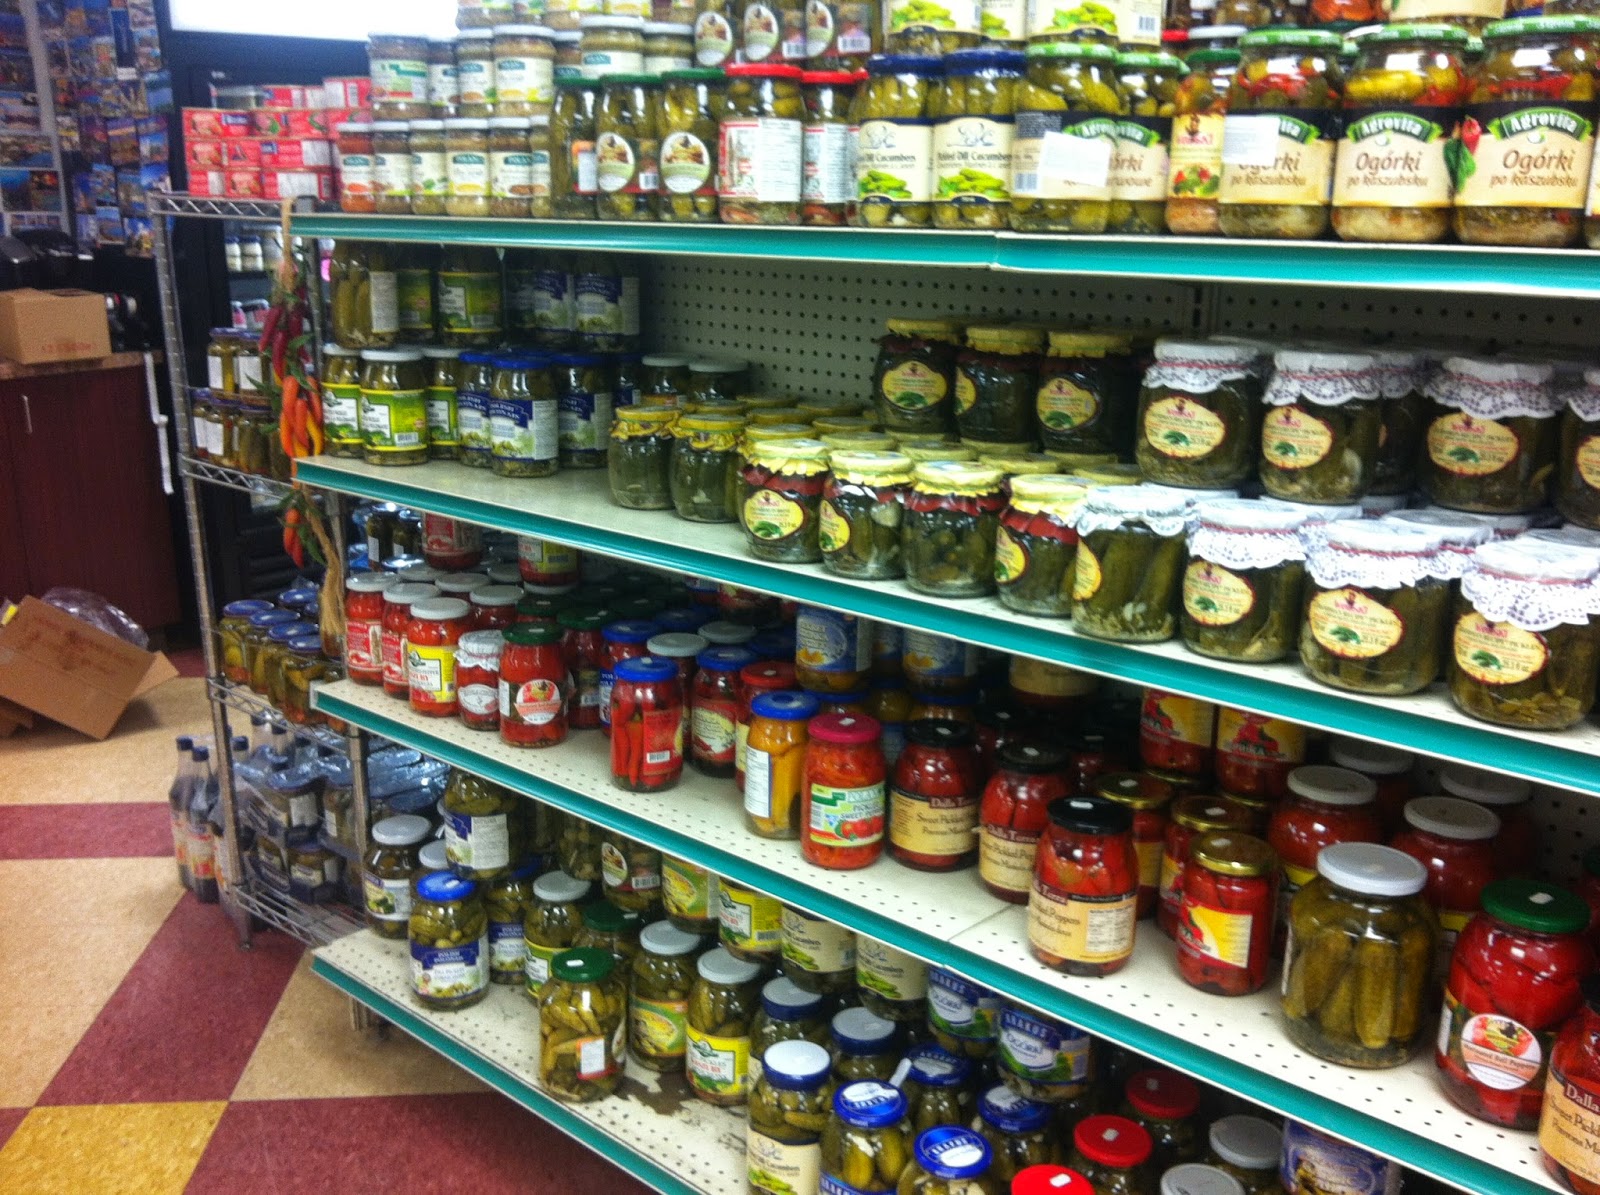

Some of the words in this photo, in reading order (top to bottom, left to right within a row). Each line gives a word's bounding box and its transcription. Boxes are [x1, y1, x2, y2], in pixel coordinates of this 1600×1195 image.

[1360, 117, 1423, 136] Agrovita
[1510, 111, 1578, 133] Agrovita
[1355, 150, 1423, 177] Ogórki
[1502, 149, 1575, 175] Ogórki
[1566, 1082, 1600, 1113] Dalla
